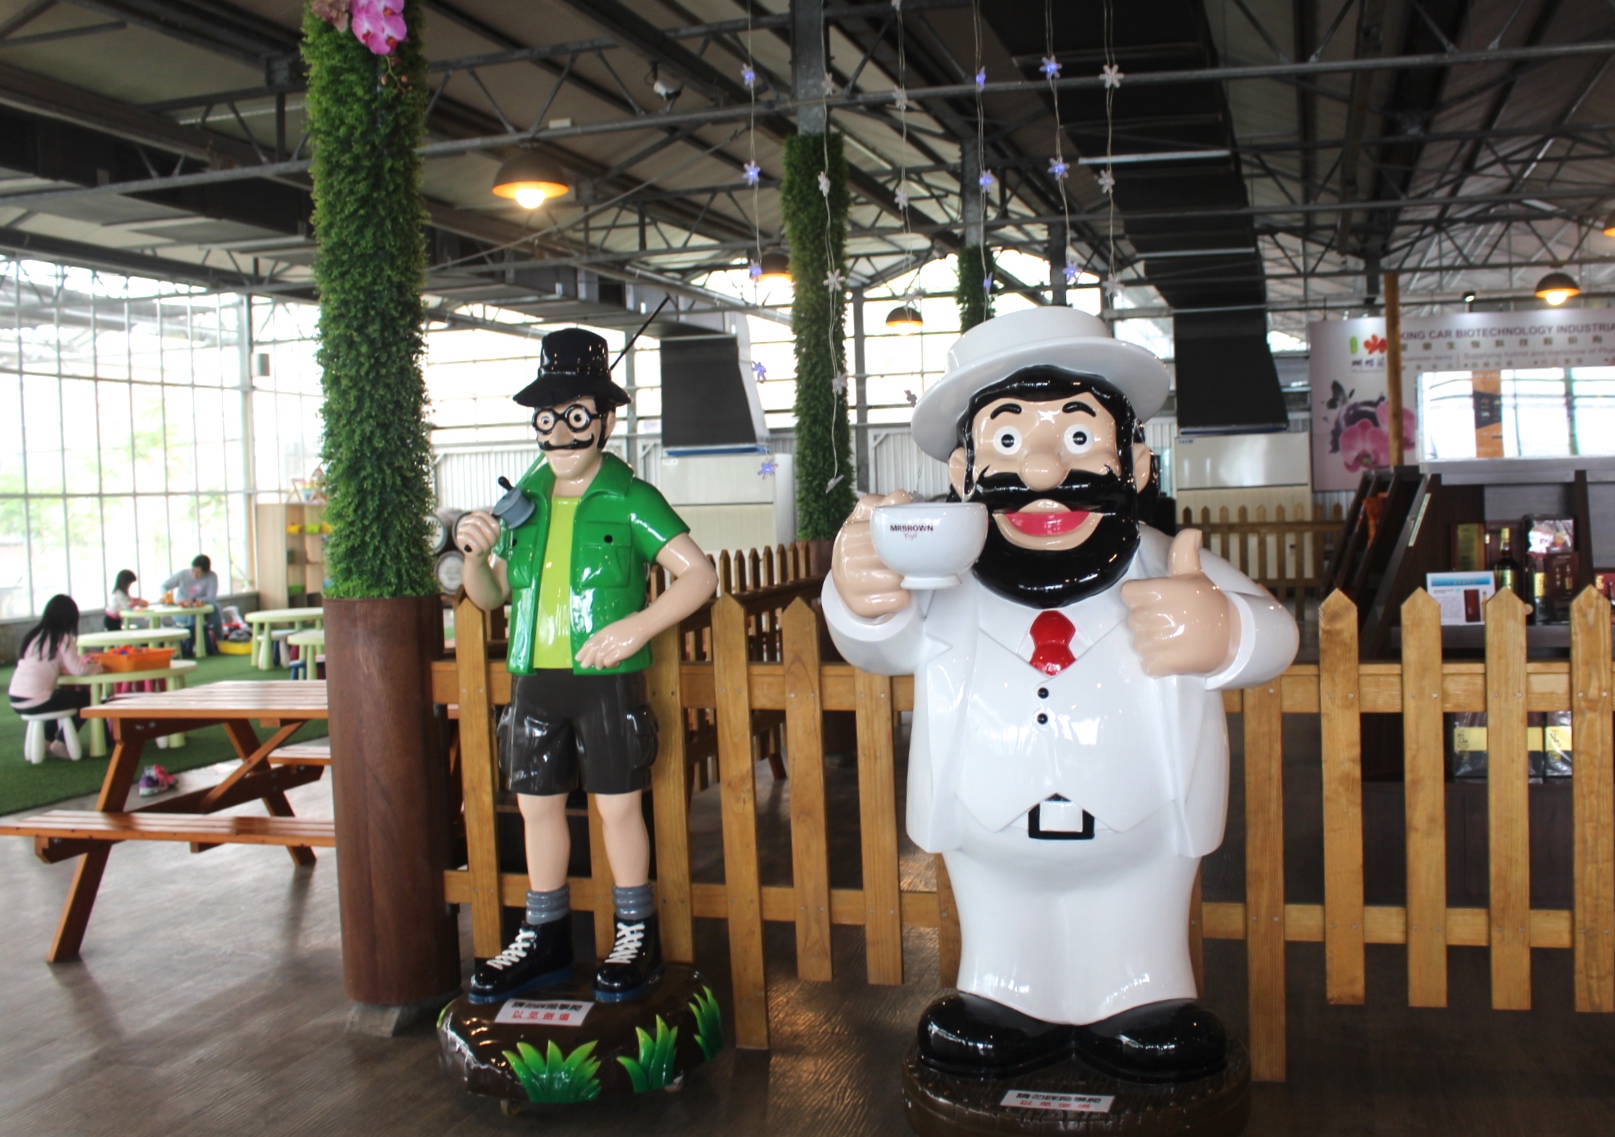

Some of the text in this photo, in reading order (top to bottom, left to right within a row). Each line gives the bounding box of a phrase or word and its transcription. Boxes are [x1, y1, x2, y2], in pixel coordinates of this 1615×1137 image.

[1401, 330, 1426, 340] KING
[1428, 329, 1453, 339] CAR
[1455, 325, 1554, 338] BIOTECHNOLOGY
